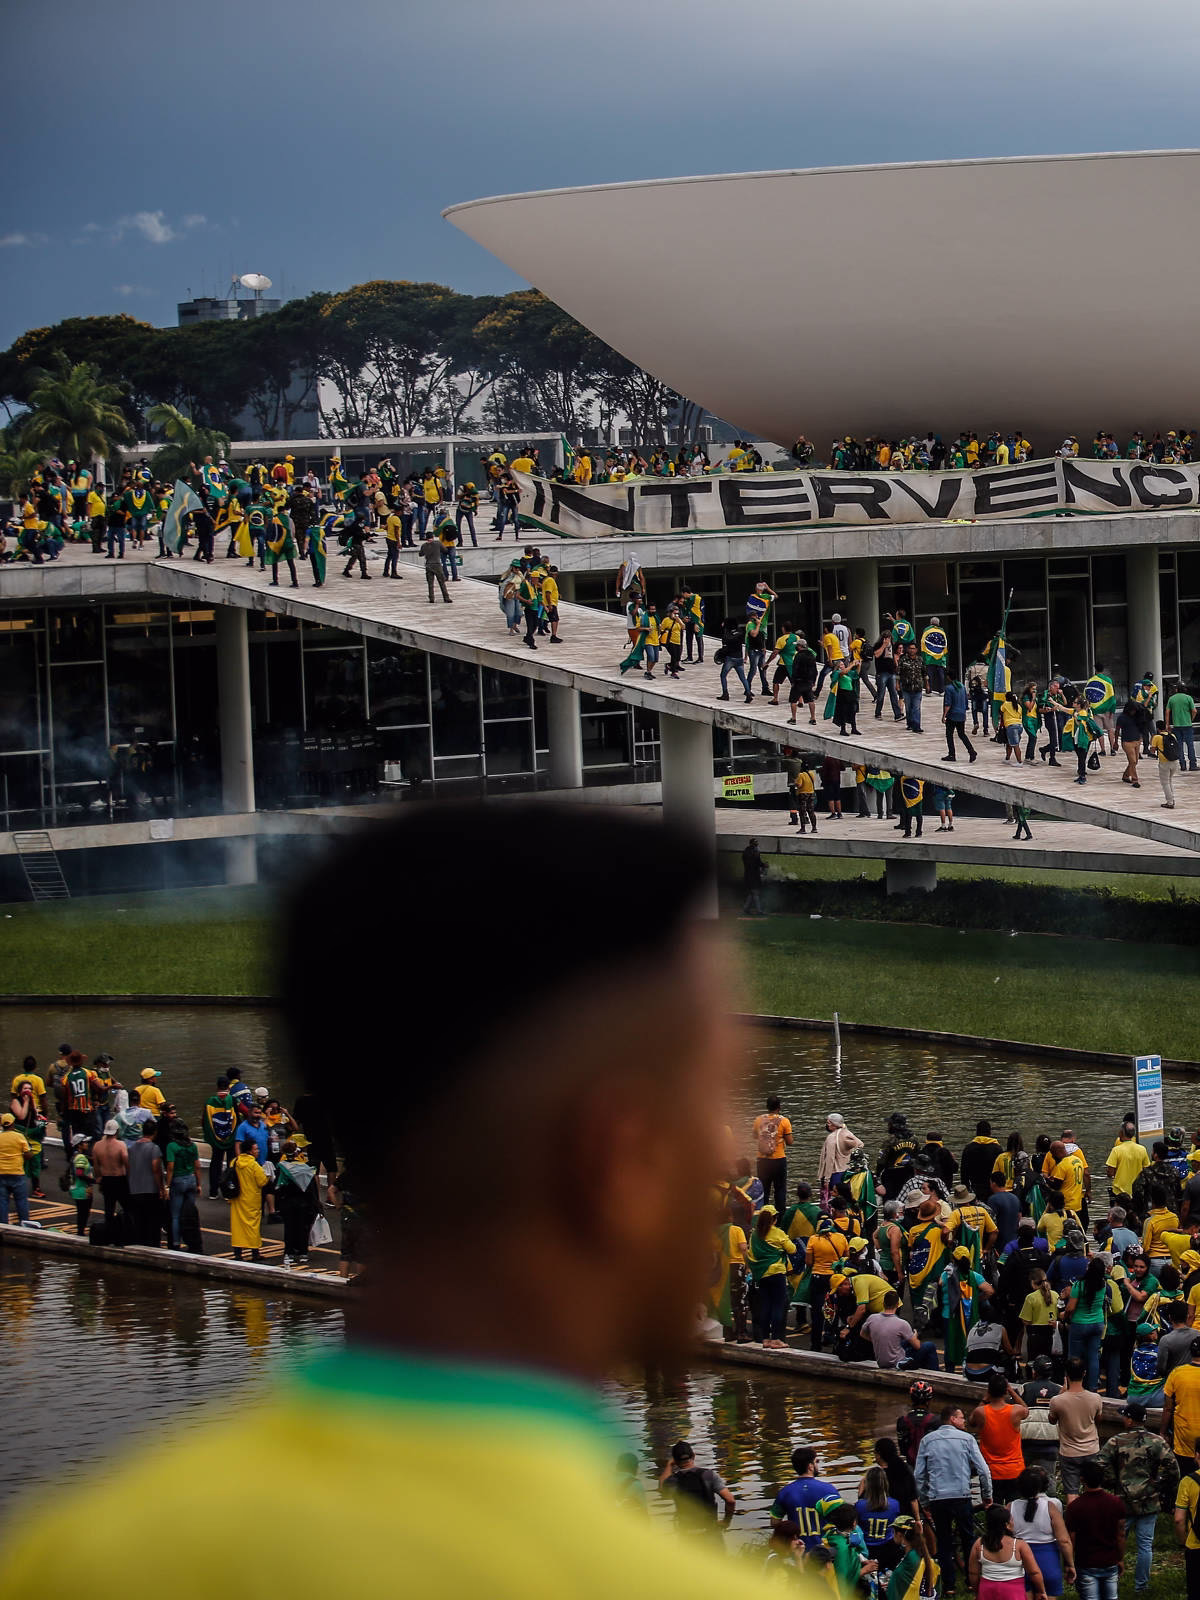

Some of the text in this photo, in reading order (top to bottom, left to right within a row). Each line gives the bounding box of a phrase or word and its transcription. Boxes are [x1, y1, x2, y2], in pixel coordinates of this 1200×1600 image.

[725, 788, 751, 797] MILITAR
[71, 1078, 86, 1095] 10
[1074, 1165, 1084, 1184] 10
[796, 1506, 821, 1537] 10
[868, 1517, 889, 1539] 10
